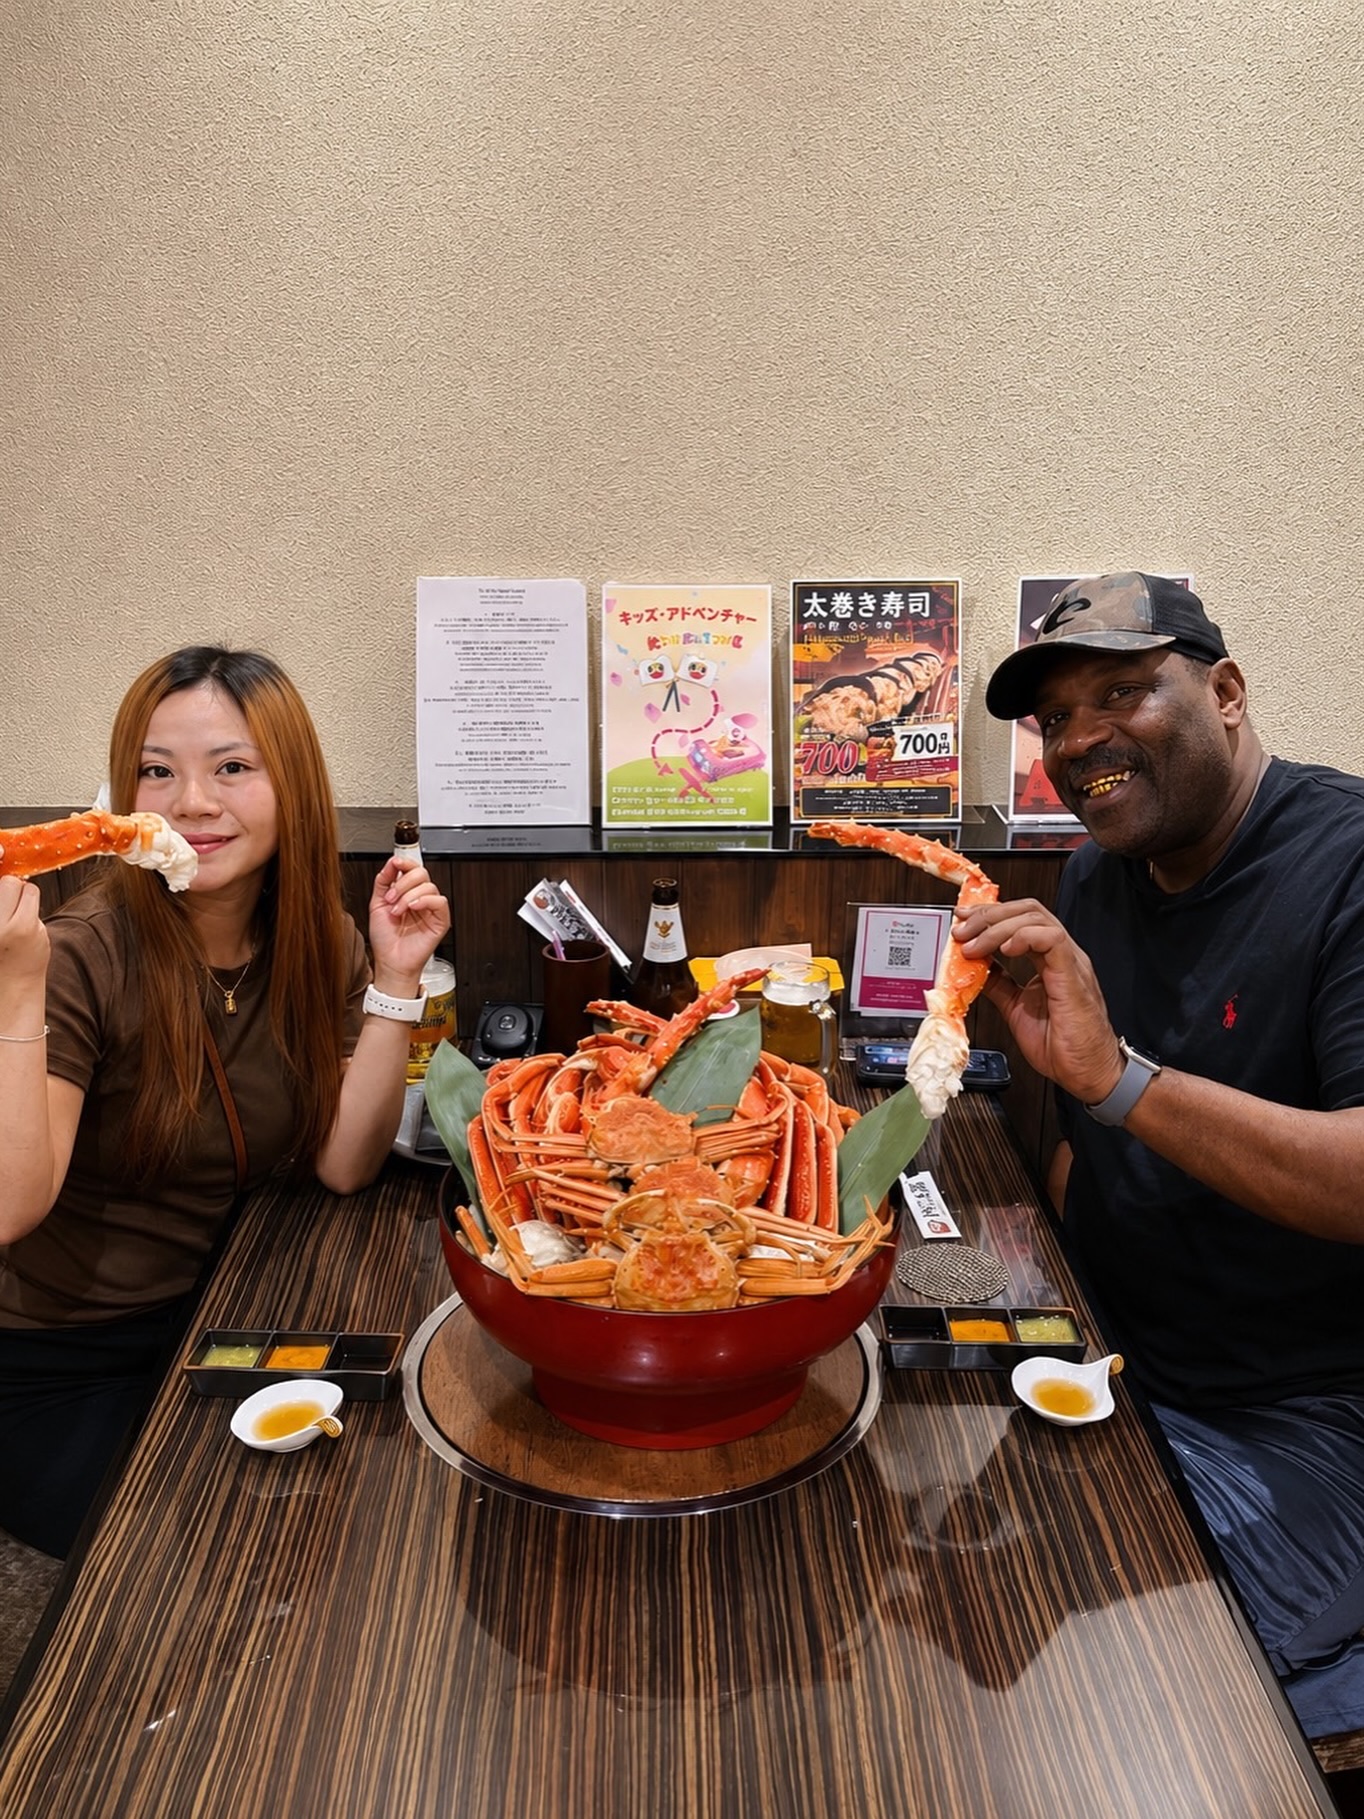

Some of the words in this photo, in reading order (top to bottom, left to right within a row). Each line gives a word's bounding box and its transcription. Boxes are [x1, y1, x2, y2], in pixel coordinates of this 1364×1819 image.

[618, 607, 757, 625] キッズ・アドベンチャー
[802, 591, 930, 618] 太巻き寿司
[800, 740, 858, 774] 700
